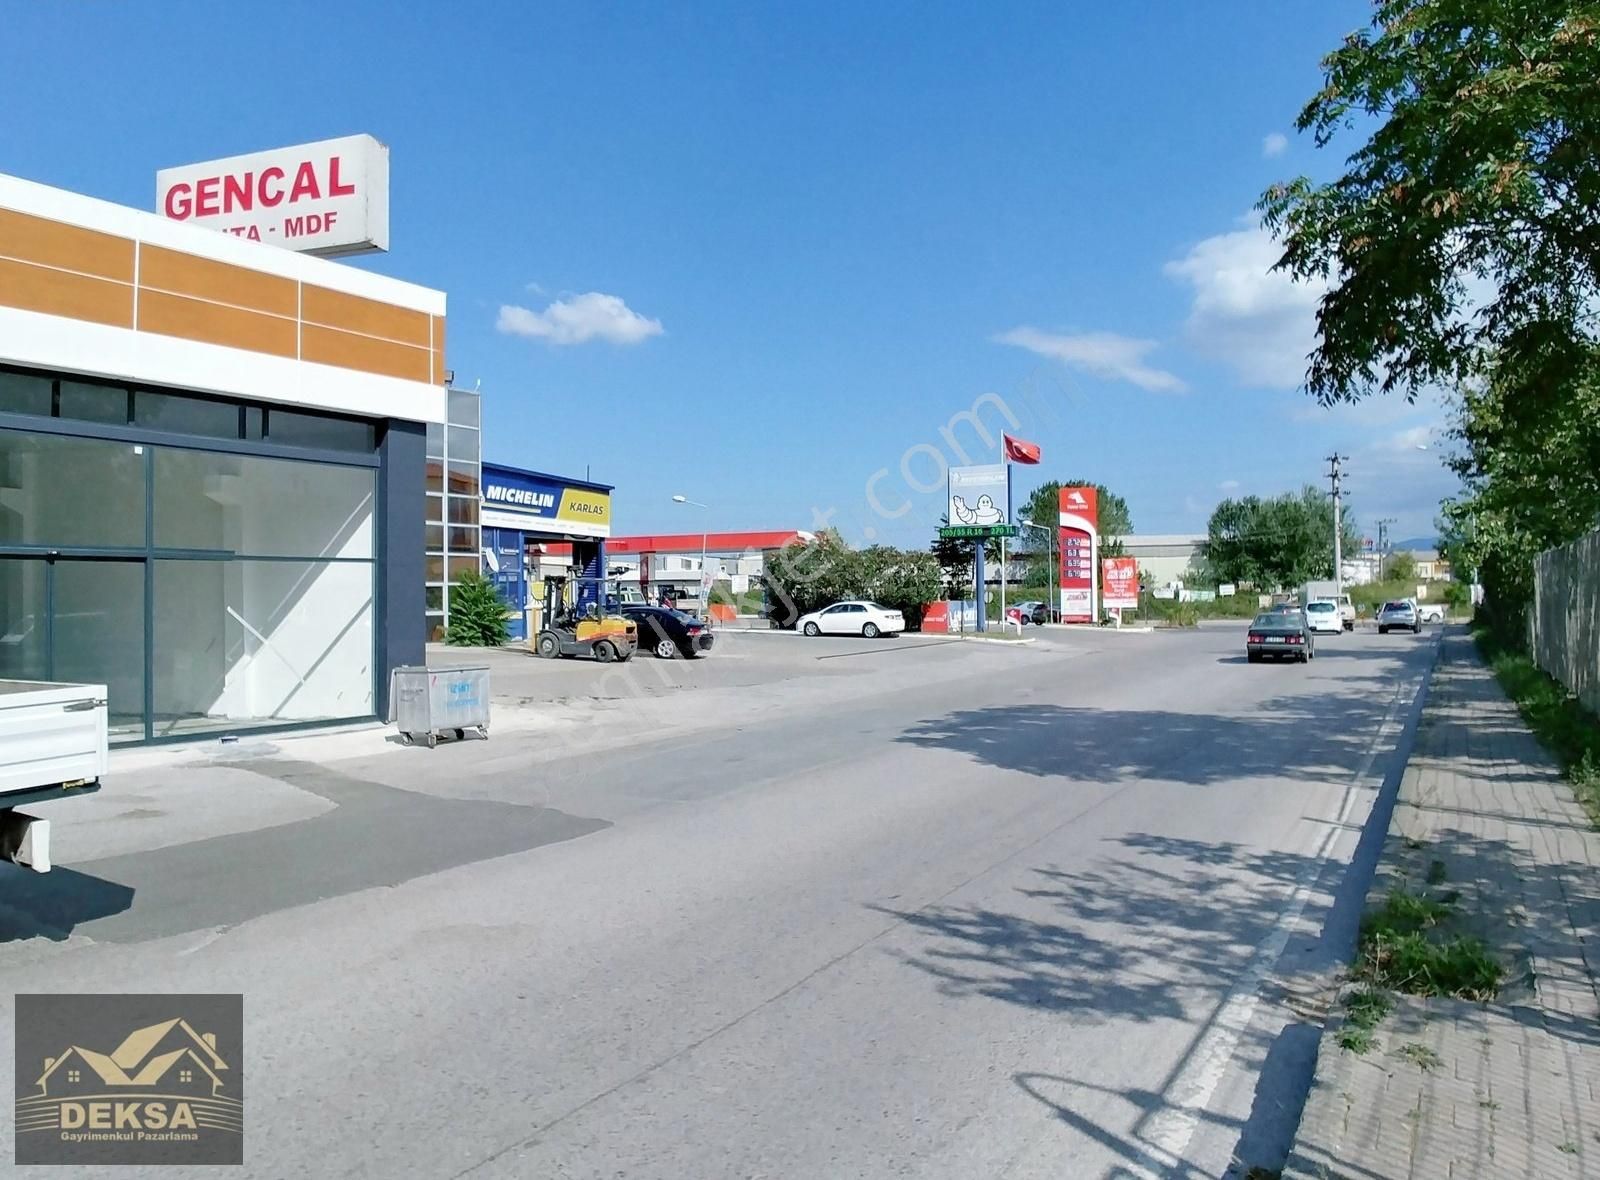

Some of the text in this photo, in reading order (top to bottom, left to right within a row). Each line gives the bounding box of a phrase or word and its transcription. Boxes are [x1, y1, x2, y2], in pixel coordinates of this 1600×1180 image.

[165, 157, 355, 221] GENCAL
[284, 212, 337, 238] MDF
[486, 485, 554, 507] MICHELIN
[569, 502, 603, 515] KARLAS
